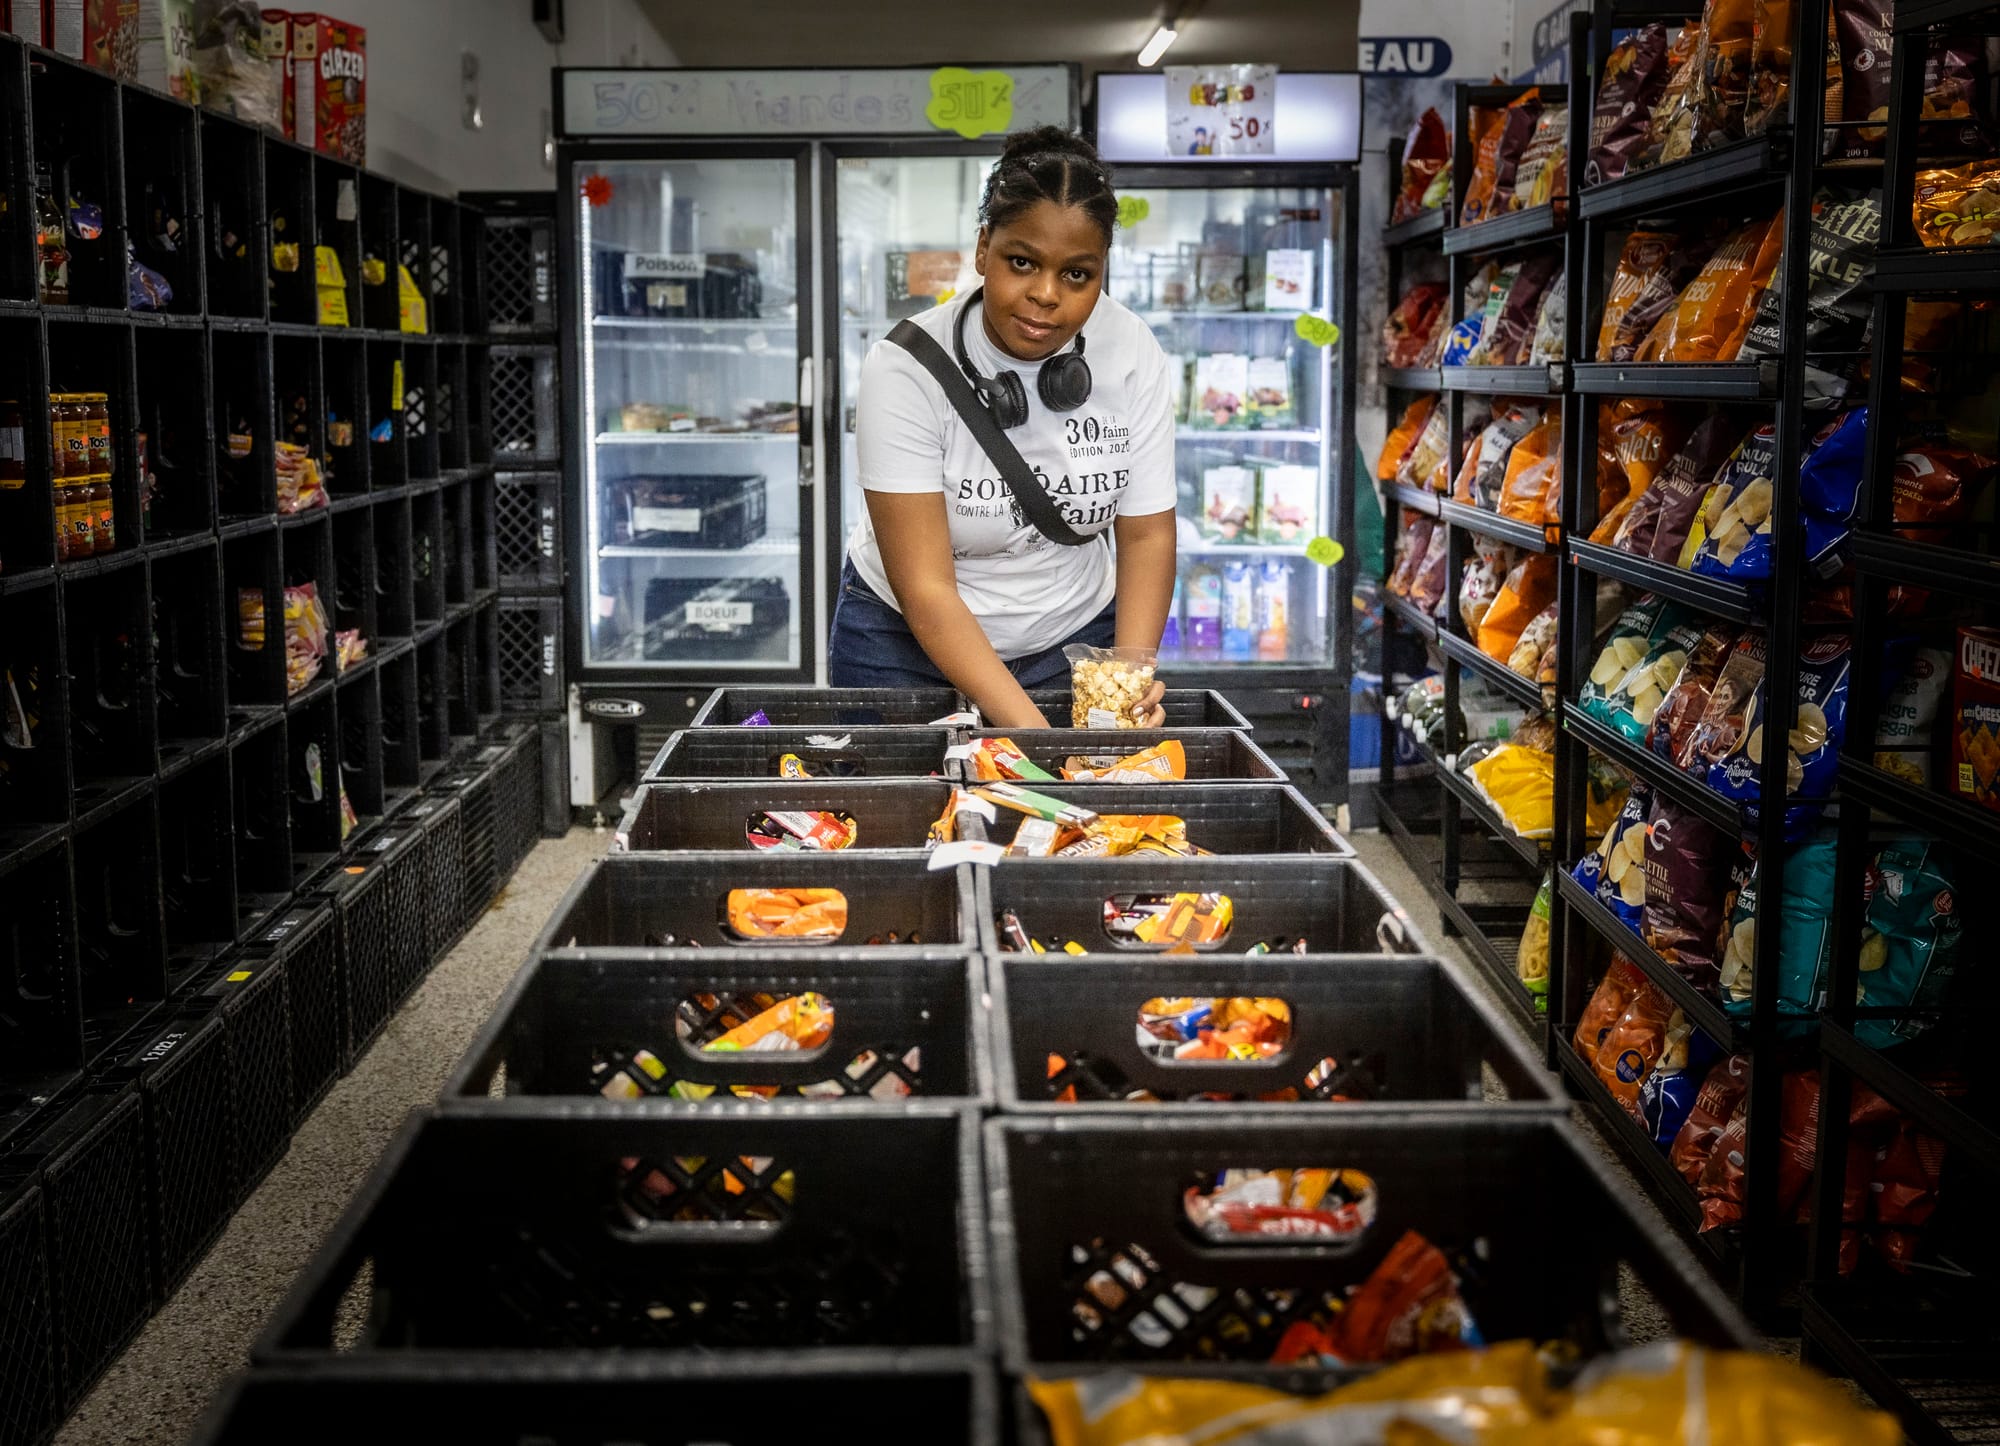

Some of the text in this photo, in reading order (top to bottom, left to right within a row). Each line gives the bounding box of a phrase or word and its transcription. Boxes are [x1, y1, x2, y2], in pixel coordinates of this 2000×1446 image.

[1810, 231, 1837, 250] RAND
[635, 255, 698, 273] Poisson
[1065, 416, 1100, 445] 30
[1103, 425, 1129, 438] faim
[957, 469, 1129, 501] SOLDAIRE
[955, 503, 990, 518] CONTRE
[994, 504, 1004, 518] LA
